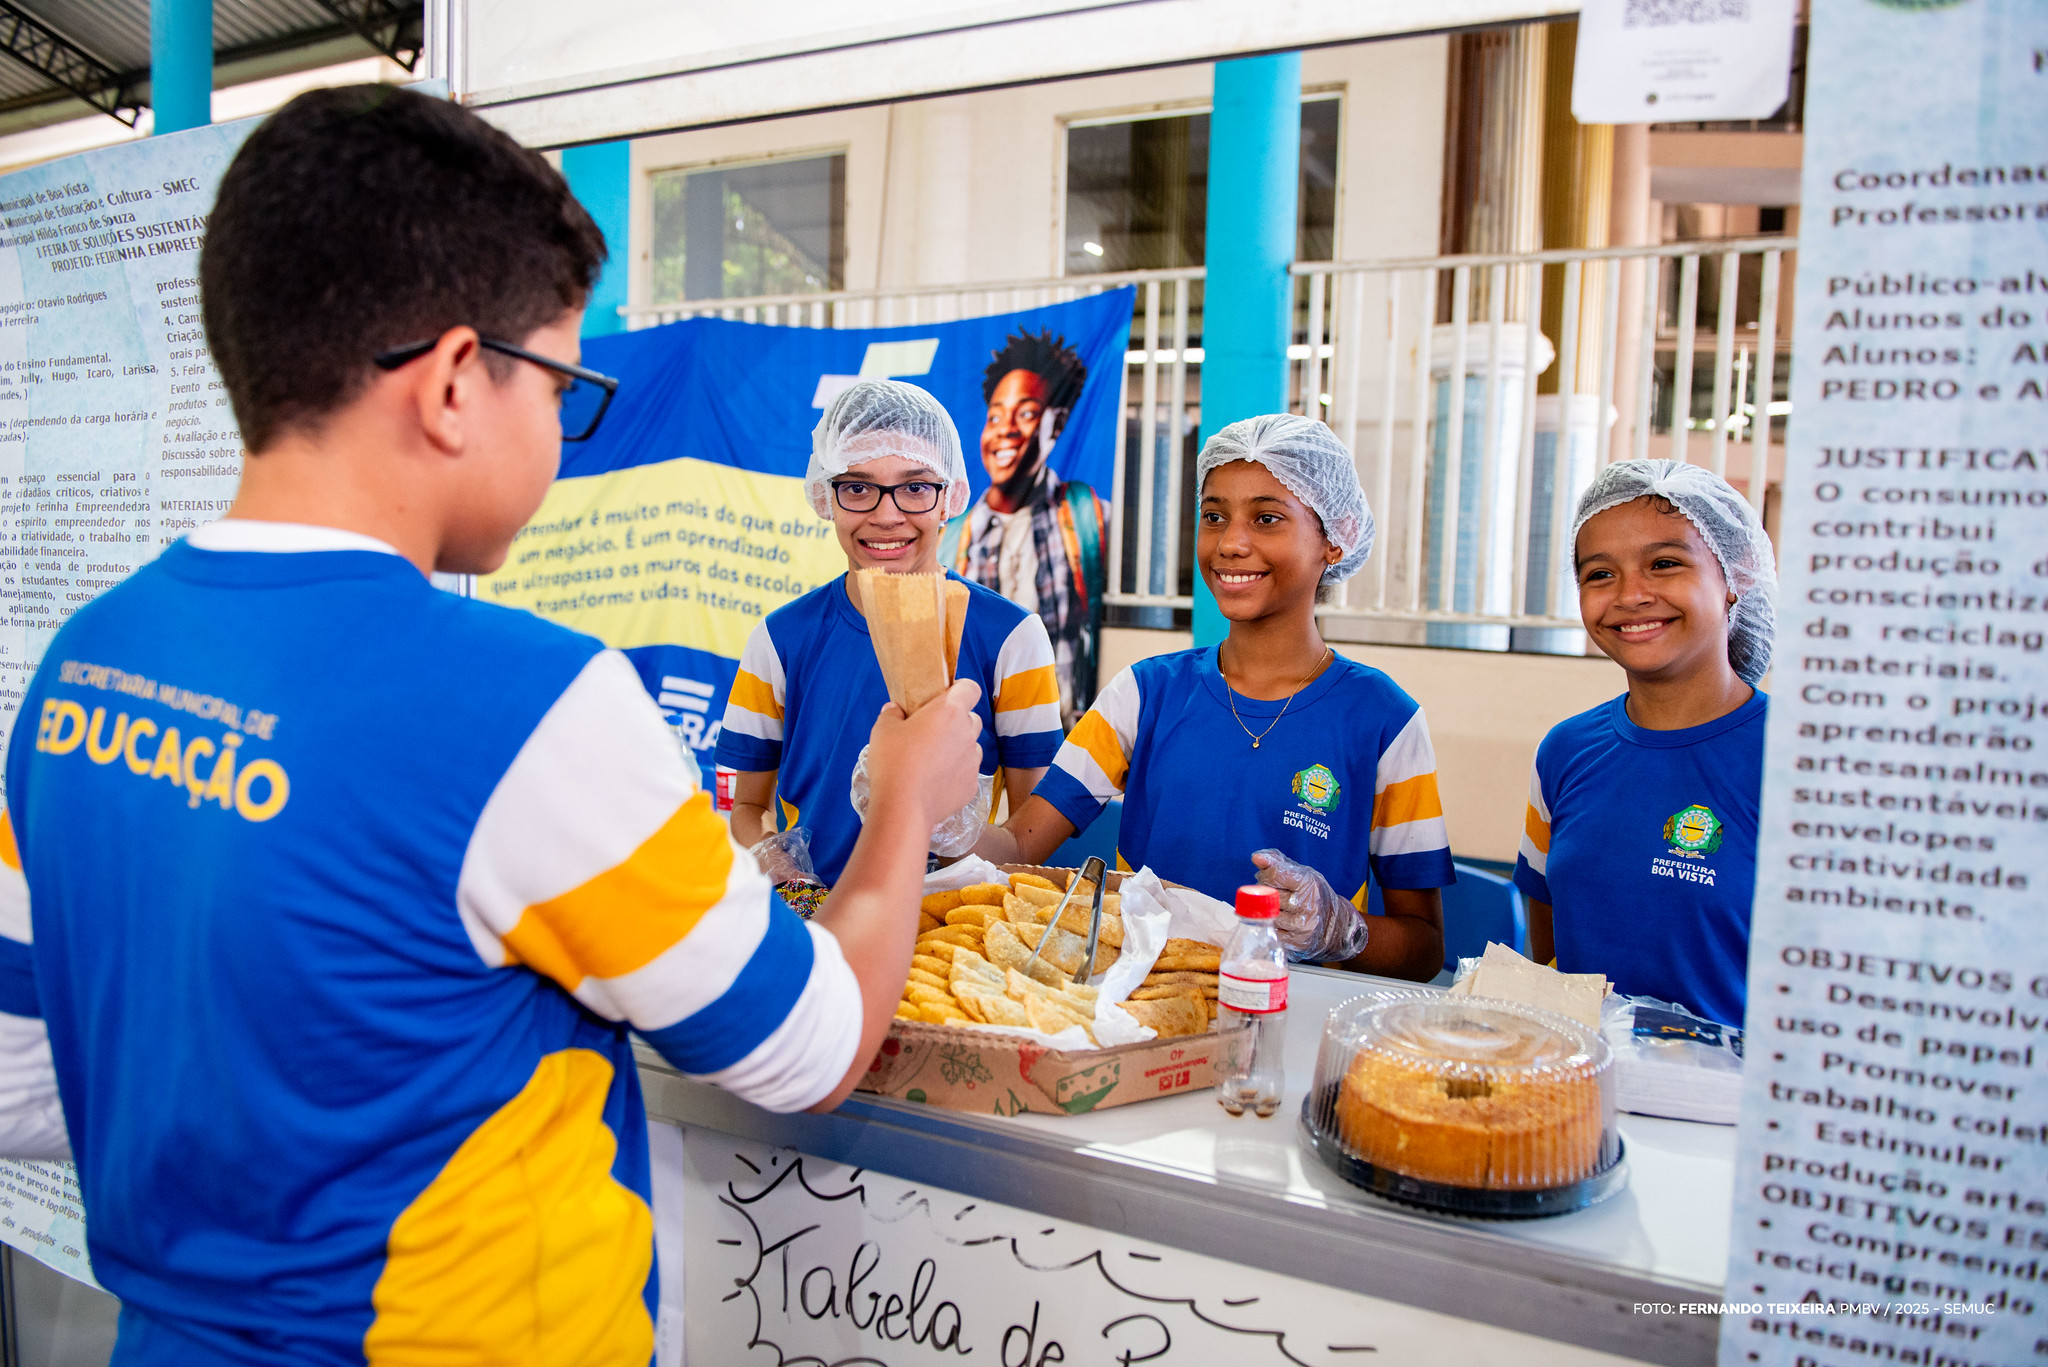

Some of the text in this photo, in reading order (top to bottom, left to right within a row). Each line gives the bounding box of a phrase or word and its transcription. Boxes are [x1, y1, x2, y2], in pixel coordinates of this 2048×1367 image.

[5, 177, 200, 228] Municipal de Educação Cultura SMEC
[36, 183, 89, 204] de Boa Vista
[36, 212, 136, 242] Hilda Franco de Souza
[42, 228, 135, 258] FEIRA DE SOLUÇÕES
[52, 245, 146, 273] PROJETO: FEIRINHA
[38, 290, 107, 309] Otavio Rodrigues
[4, 314, 39, 327] Ferreira
[164, 316, 174, 326] 4.
[1824, 304, 2031, 331] Alunos do
[167, 329, 203, 343] Criação
[4, 352, 112, 371] do Ensino Fundamental.
[170, 348, 193, 360] orais
[1823, 342, 1976, 366] Alunos:
[52, 371, 78, 384] Hugo,
[87, 368, 115, 381] Icaro,
[122, 363, 159, 378] Larissa,
[183, 364, 206, 376] Feira
[170, 382, 200, 394] Evento
[1821, 378, 1961, 402] PEDRO
[1978, 384, 2000, 401] e
[168, 398, 227, 414] produtos ou
[10, 416, 67, 432] (dependendo
[70, 412, 82, 424] da
[84, 412, 111, 426] carga
[114, 410, 148, 423] horária
[166, 416, 202, 430] negócio.
[174, 430, 218, 444] Avaliação
[162, 447, 236, 461] Discussão sobre
[18, 472, 136, 486] espaço essencial para
[161, 464, 242, 480] responsabilidade,
[2, 486, 141, 499] de cidadãos críticos, criativos
[1815, 482, 2048, 507] O consumo
[2, 502, 150, 514] projeto Ferinha Empreendedora
[161, 500, 214, 512] MATERIAIS
[15, 517, 150, 528] espírito empreendedor nos
[606, 503, 660, 527] muito
[666, 499, 709, 519] mais
[741, 512, 774, 534] que
[780, 518, 831, 540] abrir
[1812, 517, 1995, 541] contribui
[21, 531, 150, 544] criatividade, trabalho em
[641, 530, 671, 547] um
[676, 526, 790, 564] aprendizado
[40, 546, 88, 557] financeira.
[1810, 549, 2000, 578] produção
[36, 561, 130, 574] venda de produtos
[620, 562, 640, 578] os
[645, 557, 701, 577] muros
[708, 562, 740, 584] das
[744, 572, 802, 595] escola
[22, 576, 69, 587] estudantes
[66, 592, 95, 602] custos
[641, 582, 689, 603] vidas
[696, 591, 763, 618] inteiras
[8, 604, 50, 615] aplicando
[1805, 616, 1851, 640] da
[1803, 653, 2010, 684] materiais.
[1802, 684, 1928, 710] Com o
[1798, 722, 2034, 752] aprenderão
[36, 697, 290, 822] EDUCAÇÃO
[1796, 754, 2048, 788] artesanalme
[1792, 787, 2048, 822] sustentáveis
[1283, 816, 1328, 840] BOA VISTA
[1284, 810, 1330, 832] PREFEITURA
[1791, 820, 1995, 852] envelopes
[1652, 865, 1714, 887] BOA VISTA
[1653, 858, 1716, 876] PREFEITURA
[1788, 851, 2029, 890] criatividade
[1786, 886, 1986, 923] ambiente.
[1780, 946, 2012, 994] OBJETIVOS
[1775, 1015, 1841, 1038] uso
[1856, 1023, 1903, 1048] de
[1920, 1036, 2034, 1068] papel
[1822, 1052, 2020, 1102] Promover
[1769, 1080, 1936, 1125] trabalho
[1816, 1120, 2011, 1172] Estimular
[16, 1171, 25, 1182] de
[26, 1176, 48, 1192] preço
[50, 1186, 60, 1198] de
[51, 1171, 62, 1182] de
[1763, 1153, 1948, 1198] produção
[17, 1187, 38, 1204] nome
[46, 1199, 80, 1220] logotipo
[1762, 1183, 1988, 1241] OBJETIVOS
[20, 1226, 81, 1259] produtos com
[762, 1225, 972, 1355] Tabela
[1754, 1250, 2034, 1316] reciclagem do
